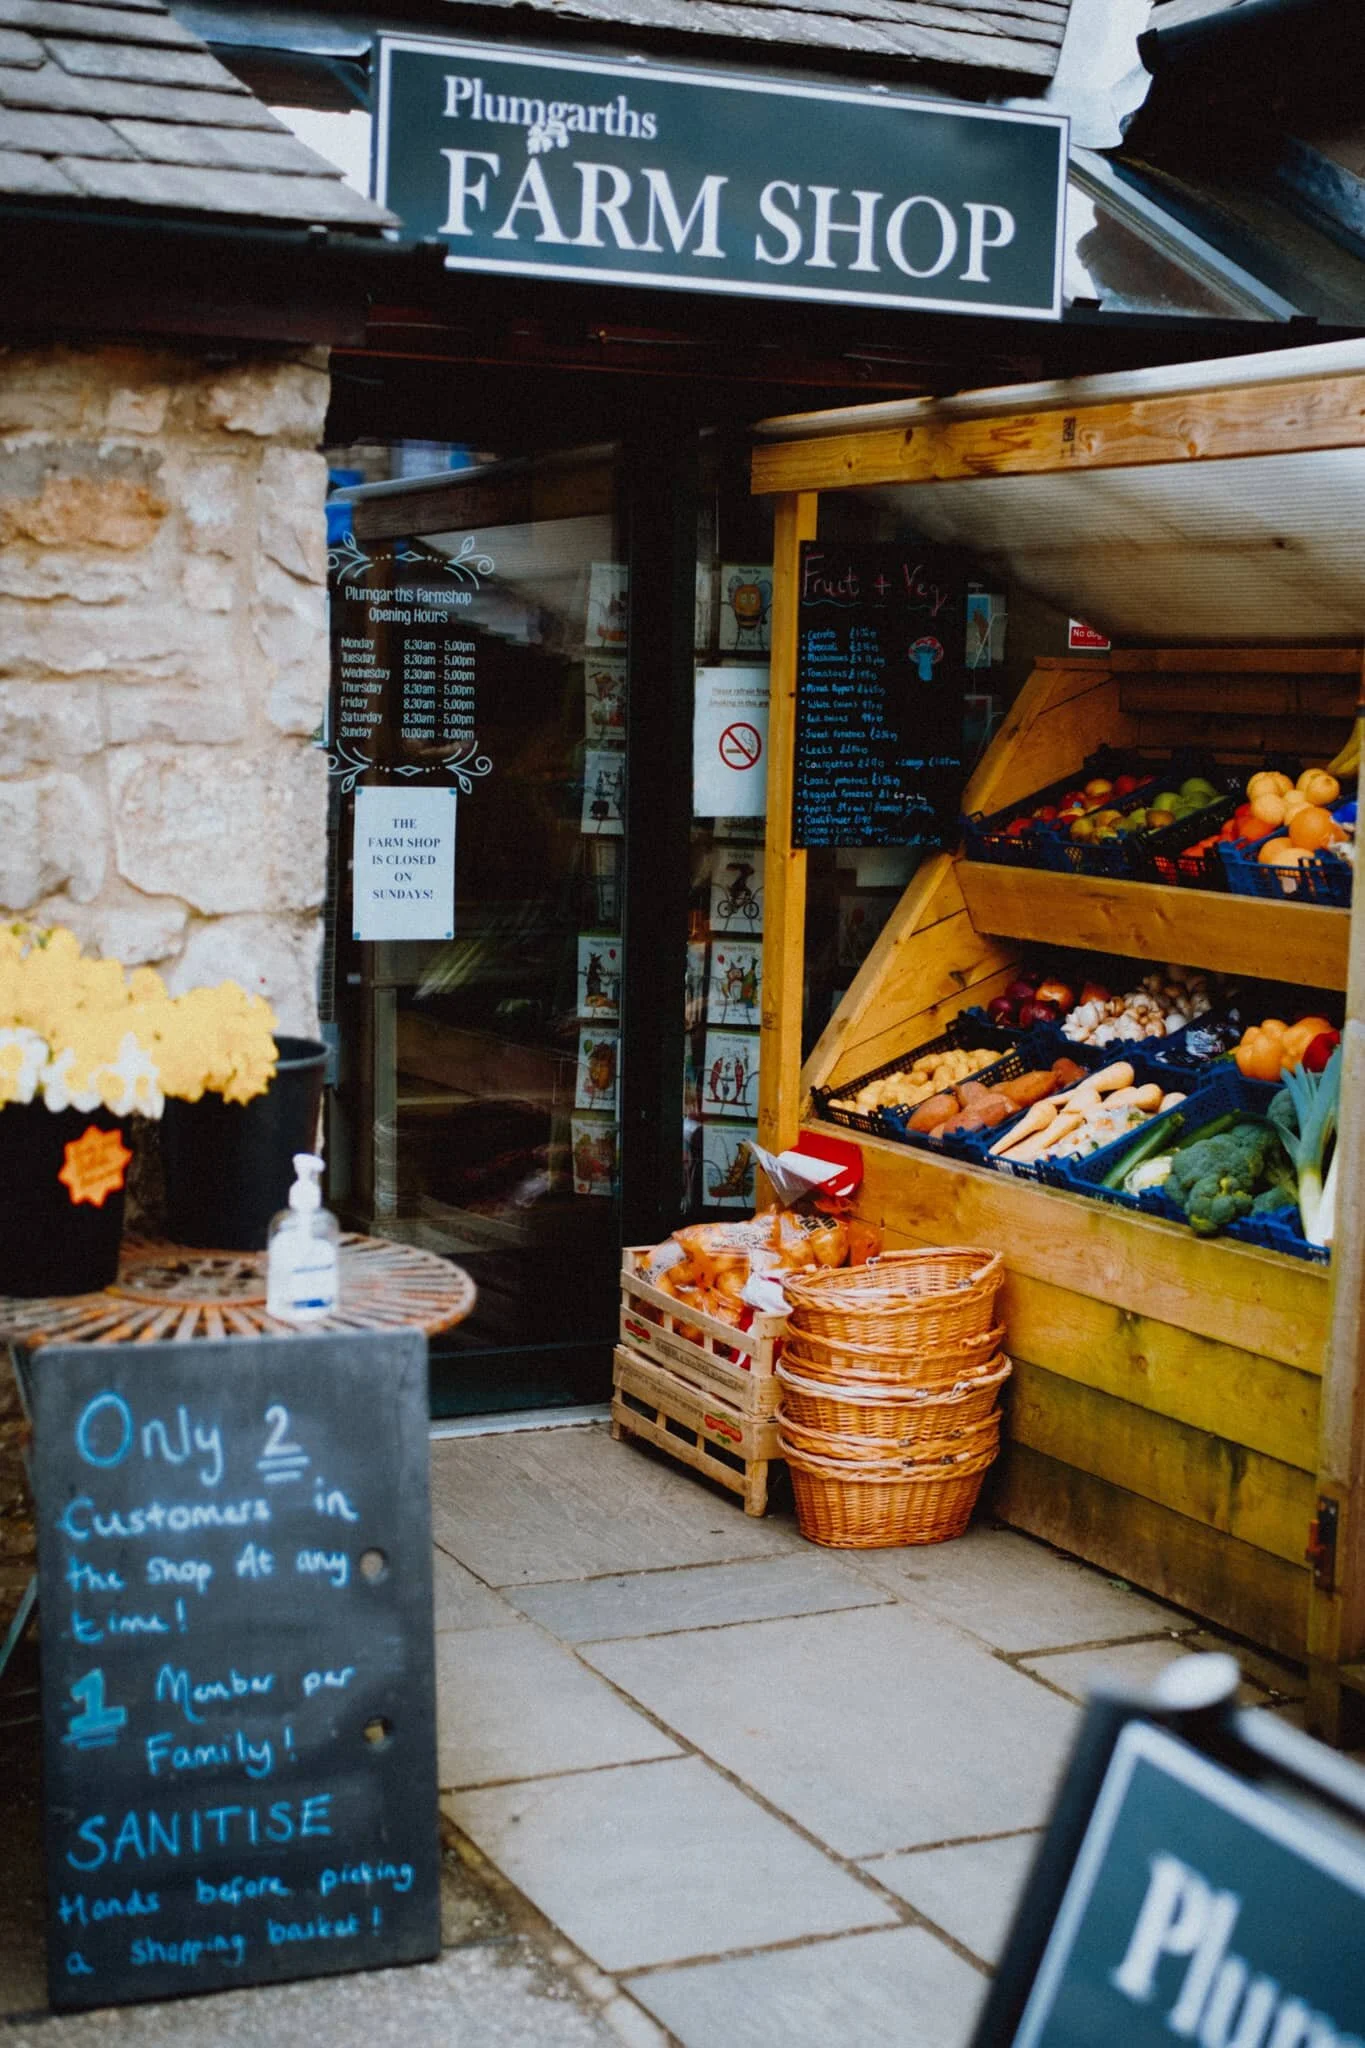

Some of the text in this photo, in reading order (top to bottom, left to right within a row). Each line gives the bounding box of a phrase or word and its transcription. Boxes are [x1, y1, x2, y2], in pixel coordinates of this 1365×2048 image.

[443, 75, 658, 141] Plumgarths
[437, 148, 1017, 283] FARM SHOP
[345, 585, 472, 606] Plumgarths Farmshop
[802, 554, 859, 598] Fruit
[902, 563, 948, 617] Veg
[368, 606, 448, 625] Opening Hours
[341, 638, 375, 650] Monday
[404, 639, 436, 651] 8.30am
[444, 640, 475, 652] 5.00pm
[341, 653, 376, 665] Tuesday
[403, 654, 436, 665] 8.30am
[444, 655, 475, 667] 5.00pm
[341, 667, 391, 680] Wednesday
[403, 669, 436, 680] 8.30am
[444, 669, 475, 681] 5.00pm
[342, 682, 382, 695] Thursday
[403, 684, 435, 695] 8.30am
[444, 684, 475, 696] 5.00pm
[340, 697, 368, 710] Friday
[403, 698, 435, 710] 8.30am
[444, 699, 475, 711] 5.00pm
[340, 711, 383, 725] Saturday
[403, 713, 435, 724] 8.30am
[443, 714, 475, 726] 5.00pm
[340, 726, 372, 738] Sunday
[401, 727, 435, 738] 10.00am
[443, 728, 475, 740] 4.00pm
[392, 818, 417, 829] THE
[368, 837, 441, 848] FARM SHOP
[372, 854, 436, 865] IS CLOSED
[394, 871, 412, 882] ON
[373, 889, 433, 900] SUNDAYS!
[74, 1388, 306, 1486] Only 2
[59, 1477, 359, 1542] Customers in
[66, 1555, 127, 1593] the
[296, 1549, 351, 1589] any
[61, 1599, 188, 1644] time!
[65, 1663, 355, 1738] 1 Member per
[144, 1726, 297, 1779] Family!
[66, 1792, 334, 1872] SANITISE
[58, 1861, 415, 1925] Hands before picking
[66, 1905, 383, 1977] a shopping basket!
